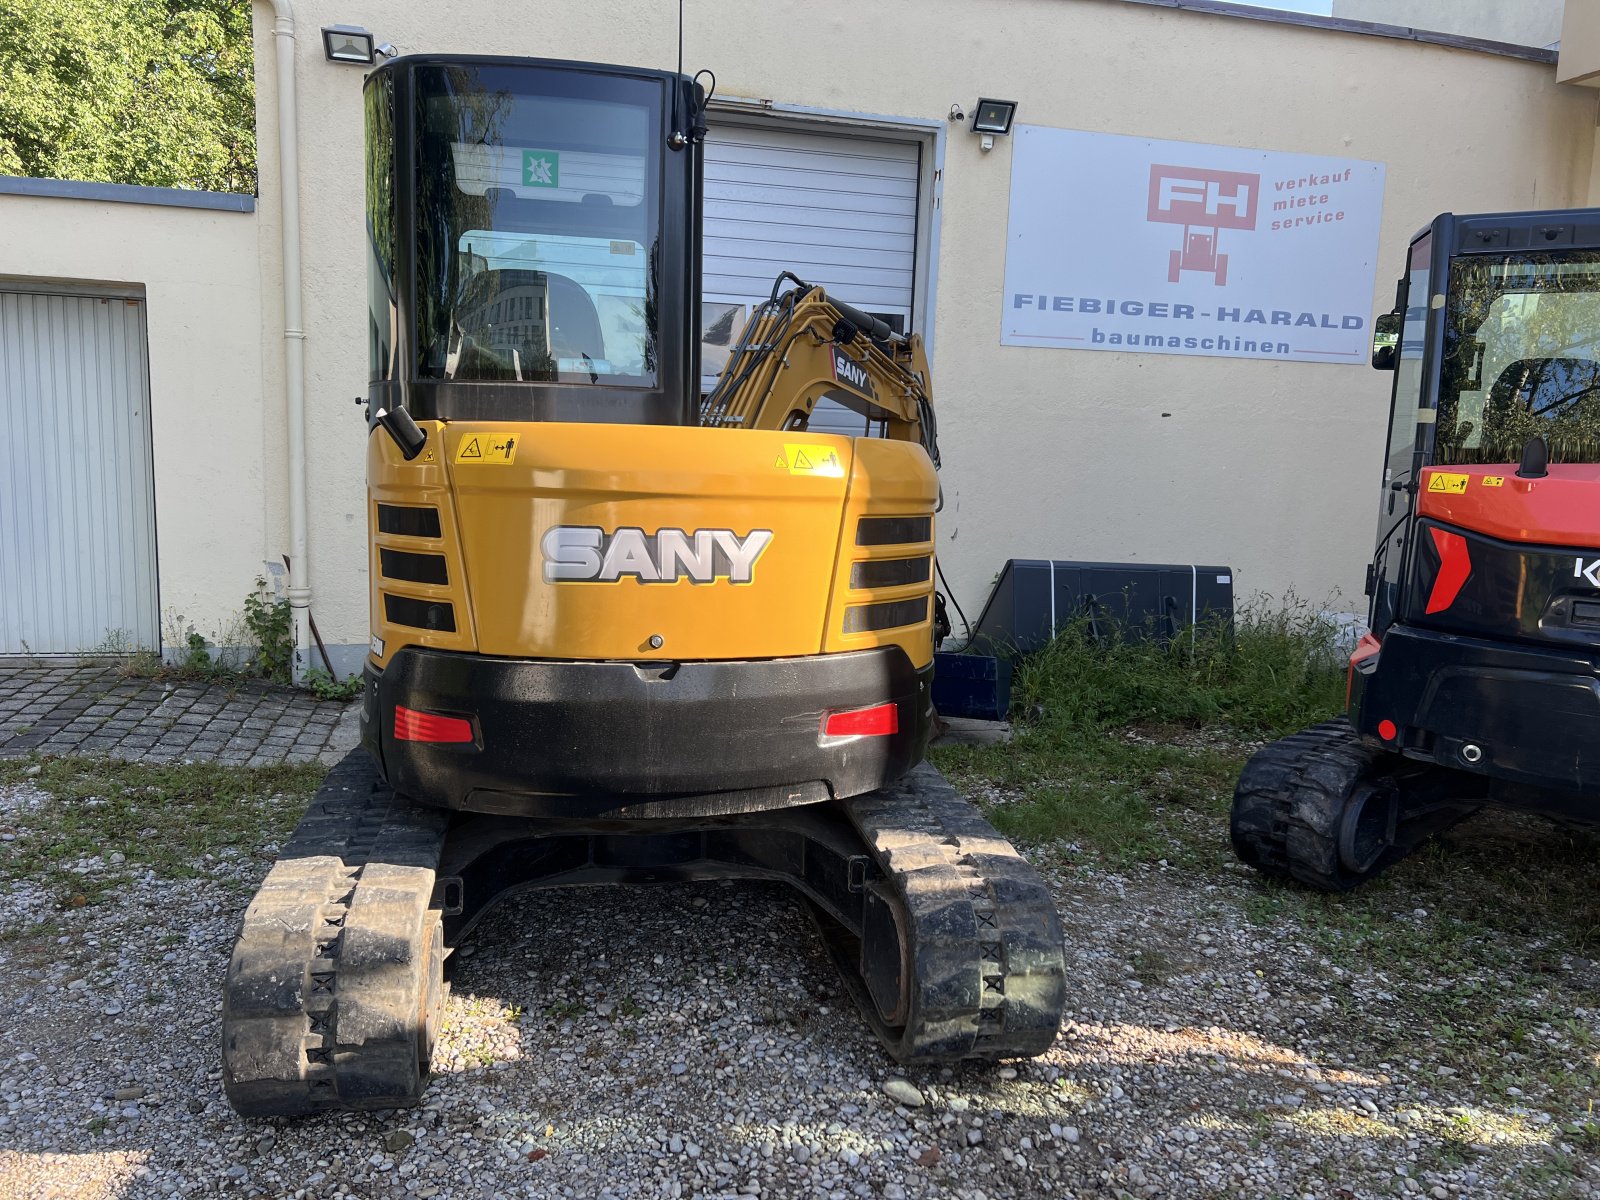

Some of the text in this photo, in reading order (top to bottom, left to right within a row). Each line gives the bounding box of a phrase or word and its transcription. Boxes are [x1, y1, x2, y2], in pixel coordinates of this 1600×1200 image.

[1274, 168, 1351, 191] verkauf
[1158, 176, 1250, 218] FH
[1273, 193, 1329, 211] miete
[1271, 210, 1345, 230] service
[1091, 328, 1290, 354] baumaschinen
[836, 356, 867, 388] SANY
[542, 526, 774, 585] SANY
